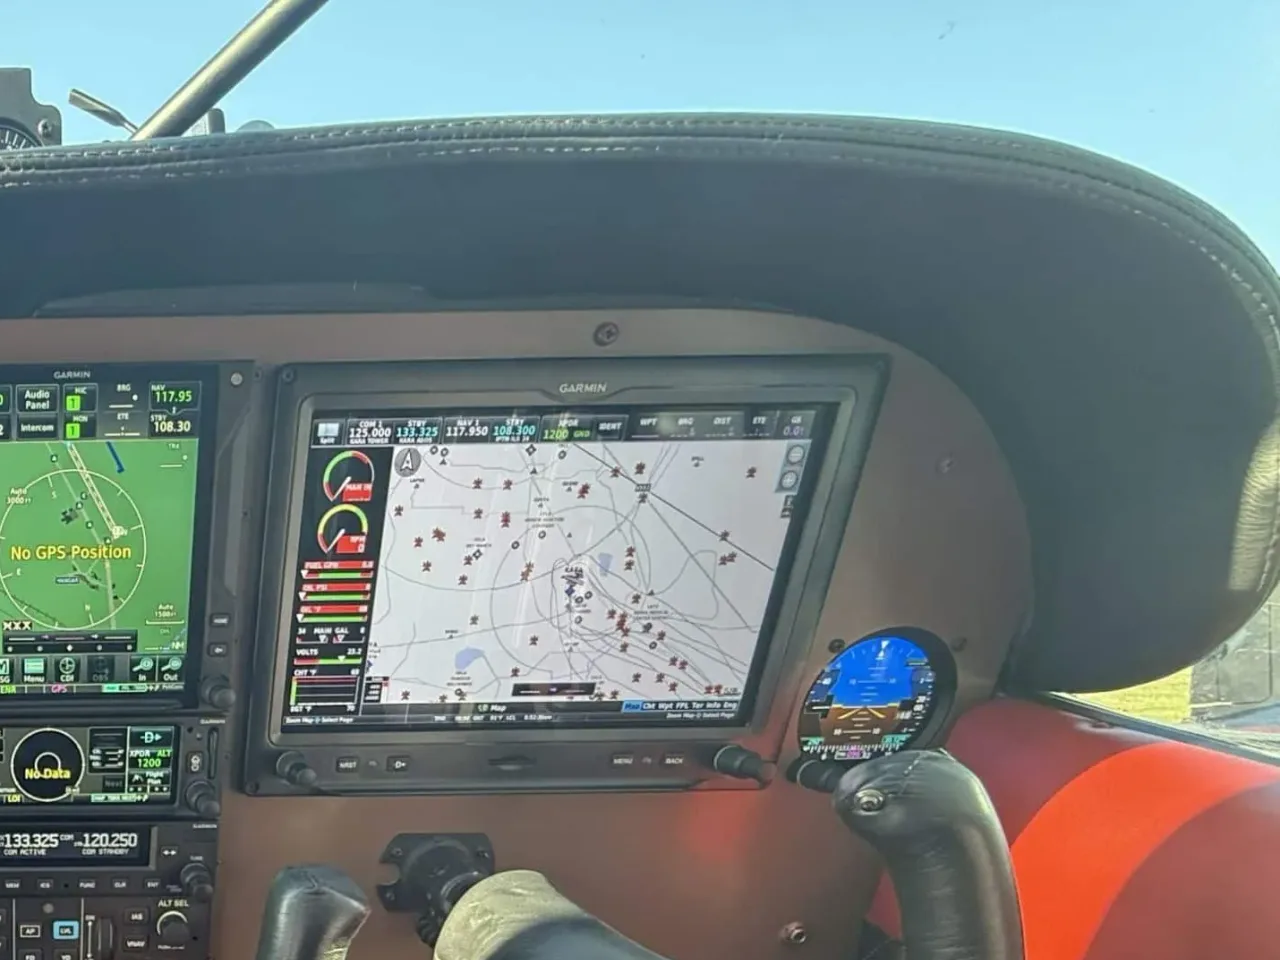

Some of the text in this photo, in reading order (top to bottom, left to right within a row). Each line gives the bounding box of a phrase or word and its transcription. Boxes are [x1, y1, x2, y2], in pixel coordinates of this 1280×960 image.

[53, 371, 91, 379] GARMIN
[559, 384, 607, 393] GARMIN
[24, 390, 50, 399] Audio
[155, 391, 193, 403] 117.95
[25, 400, 50, 410] Panel
[150, 414, 167, 422] STBY
[640, 418, 657, 426] WPT
[713, 416, 732, 425] DIST
[20, 423, 54, 432] Intercom
[154, 421, 191, 433] 108.30
[493, 425, 536, 436] 108.300
[599, 422, 622, 430] IDENT
[349, 428, 391, 438] 125.000
[395, 427, 438, 438] 133.325
[446, 426, 488, 437] 117.950
[11, 545, 132, 560] No GPS Position
[296, 648, 318, 656] VOLTS
[24, 674, 45, 683] Menu
[60, 674, 75, 683] CDI
[163, 673, 178, 681] Out
[490, 704, 507, 712] Map
[129, 749, 172, 758] XPDR ALT
[137, 758, 161, 768] 1200
[24, 768, 71, 779] No Data
[4, 833, 59, 848] 133.325
[83, 833, 138, 847] 120.250
[20, 848, 47, 856] ACTIVE
[98, 848, 130, 856] STANDBY
[157, 900, 172, 908] ALT
[126, 940, 146, 948] VNAV
